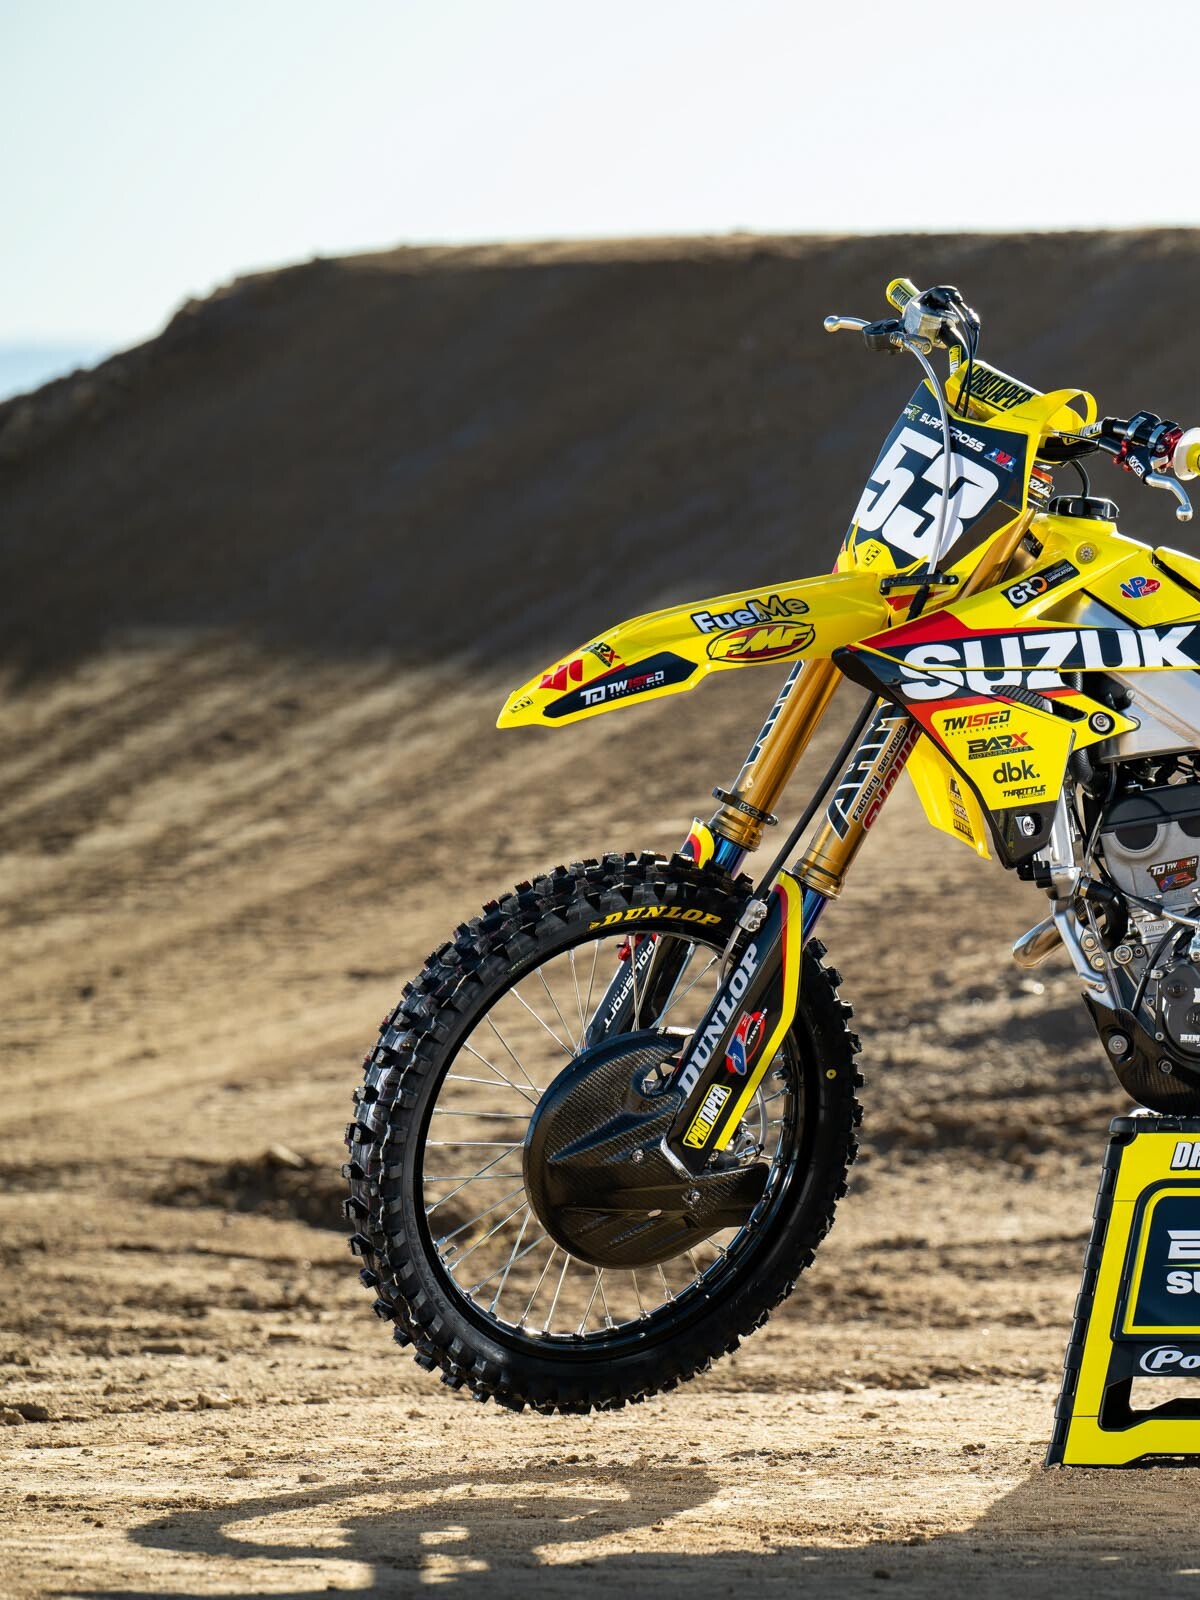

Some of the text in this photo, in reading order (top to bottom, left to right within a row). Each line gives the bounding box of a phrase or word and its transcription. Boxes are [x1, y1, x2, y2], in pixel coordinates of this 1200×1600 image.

[853, 427, 999, 564] 53
[1007, 576, 1048, 604] GRO
[1120, 576, 1147, 598] VP
[690, 595, 809, 633] FuelMe
[710, 624, 814, 659] FMF
[607, 671, 664, 694] TWISTED
[943, 710, 1011, 732] TWISTED
[945, 724, 1010, 737] DEVELOPMENT
[967, 732, 1029, 754] BARX
[852, 723, 908, 823] Factory services
[1003, 785, 1046, 798] THROTTLE
[600, 905, 722, 927] DUNLOP
[604, 940, 656, 1030] POLSPORT
[677, 943, 758, 1099] DUNLOP
[746, 1008, 768, 1045] PISTONS
[685, 1084, 730, 1148] PROTAPER
